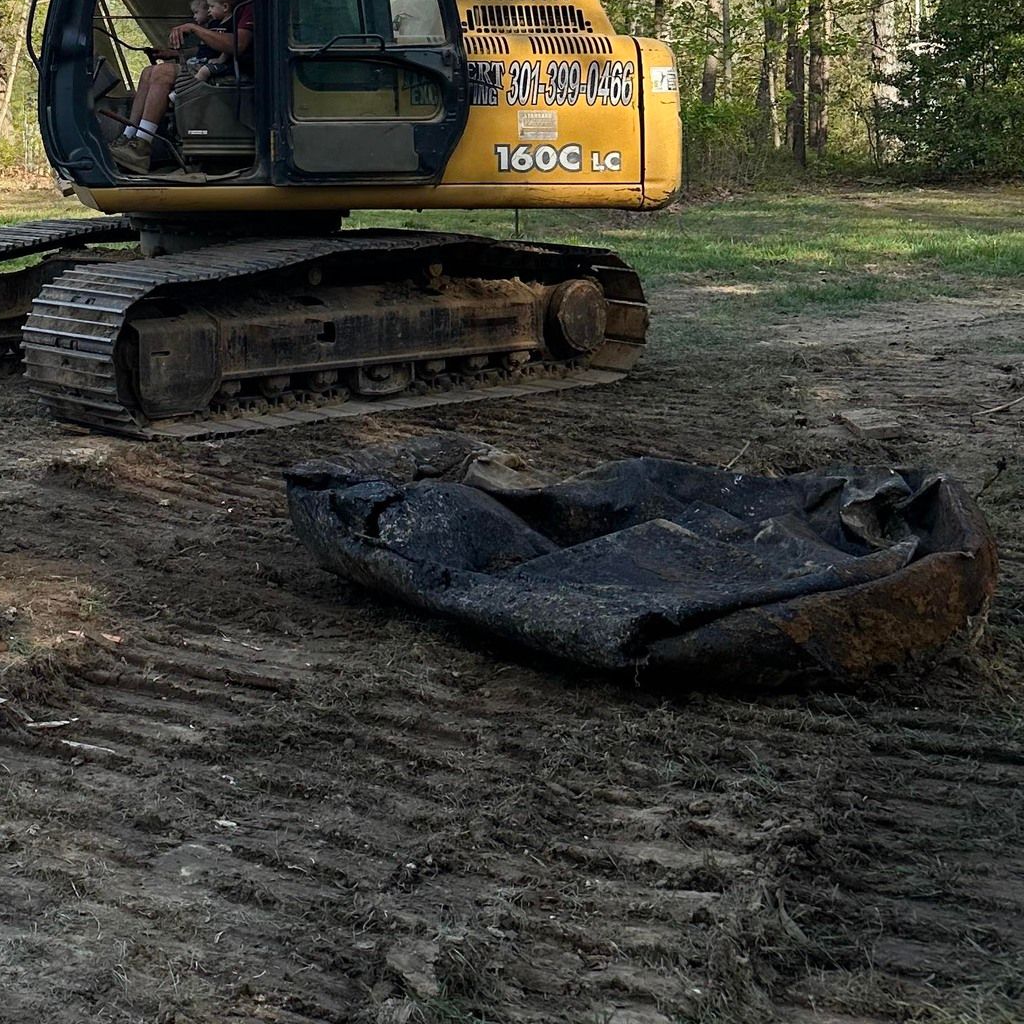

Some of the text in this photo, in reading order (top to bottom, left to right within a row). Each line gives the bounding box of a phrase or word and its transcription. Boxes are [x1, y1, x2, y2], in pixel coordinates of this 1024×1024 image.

[467, 62, 505, 89] ERT
[507, 60, 634, 106] 301-399-0466
[472, 85, 498, 105] ING
[495, 144, 622, 172] 160C LC
